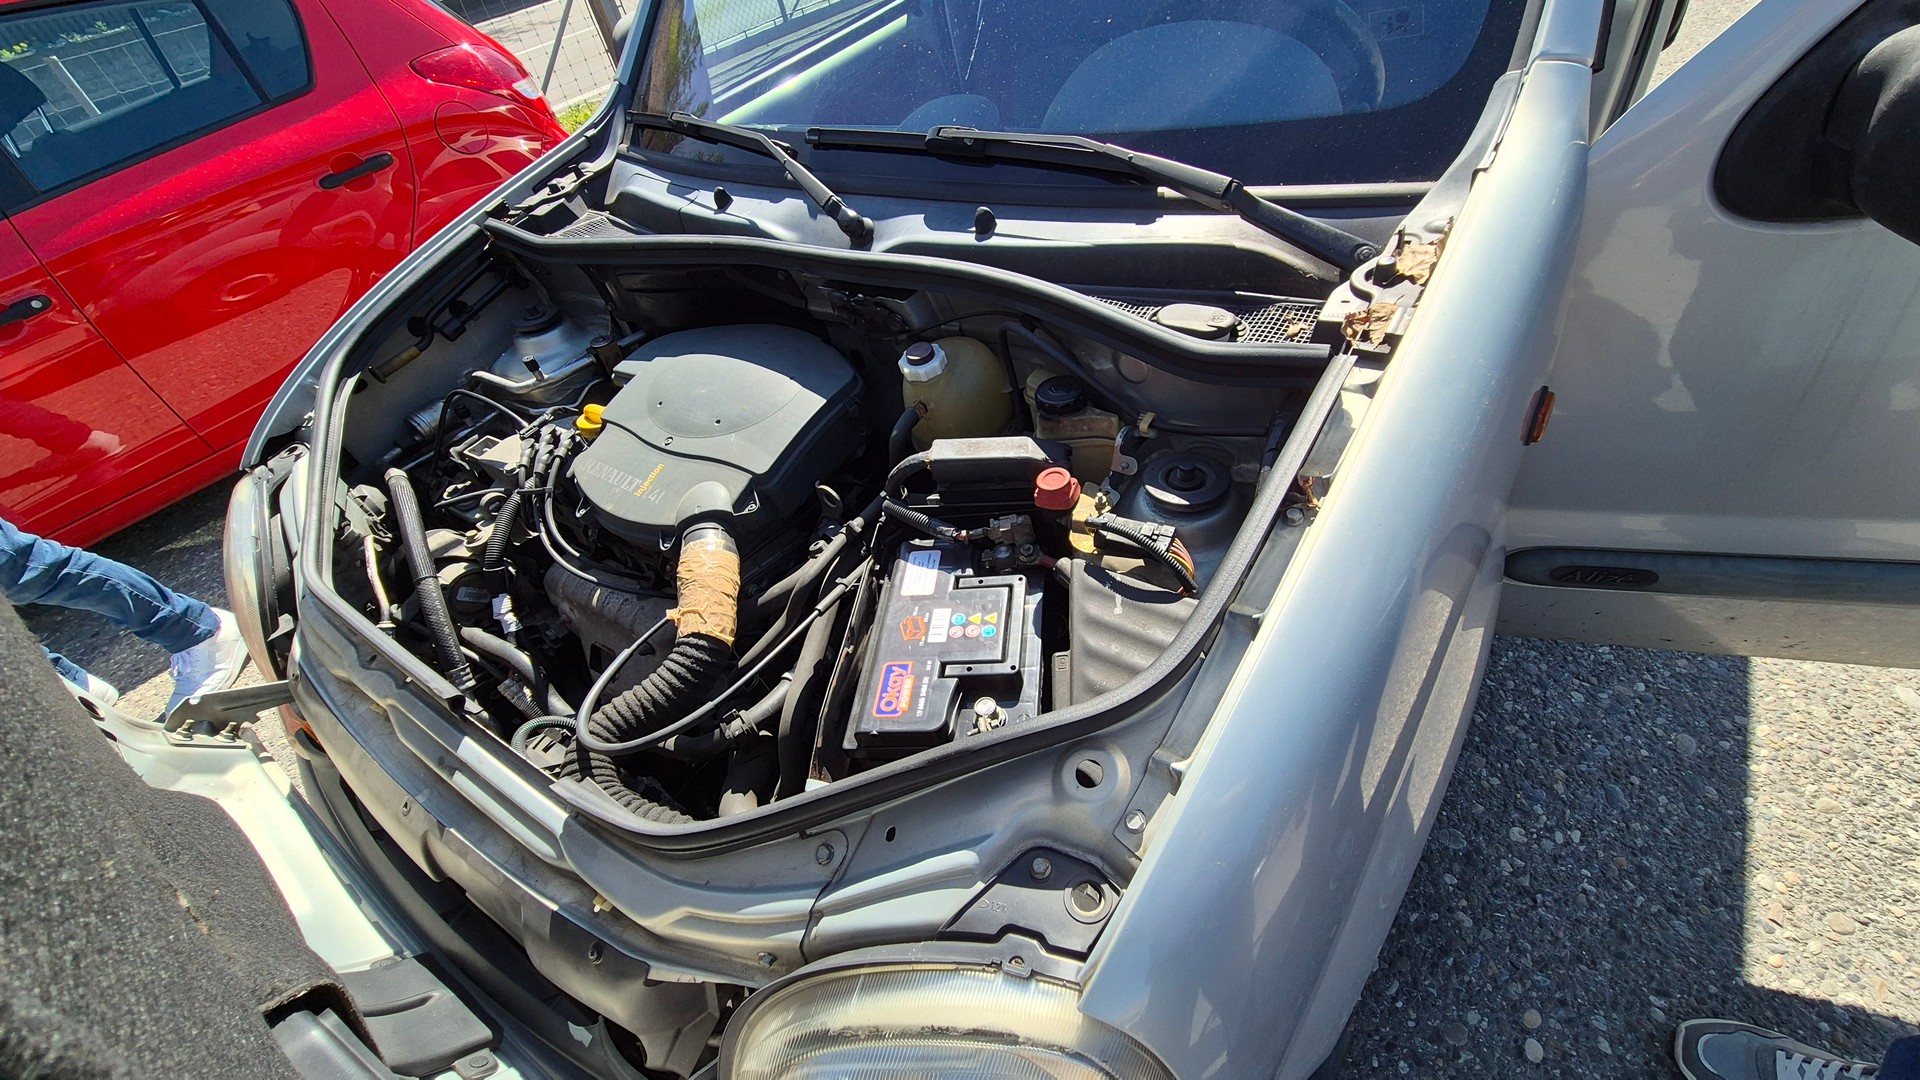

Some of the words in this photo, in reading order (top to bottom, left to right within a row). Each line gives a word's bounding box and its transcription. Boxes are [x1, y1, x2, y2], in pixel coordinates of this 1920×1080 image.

[582, 459, 642, 492] RENAULT
[880, 666, 907, 712] Okay
[899, 678, 912, 708] POWER
